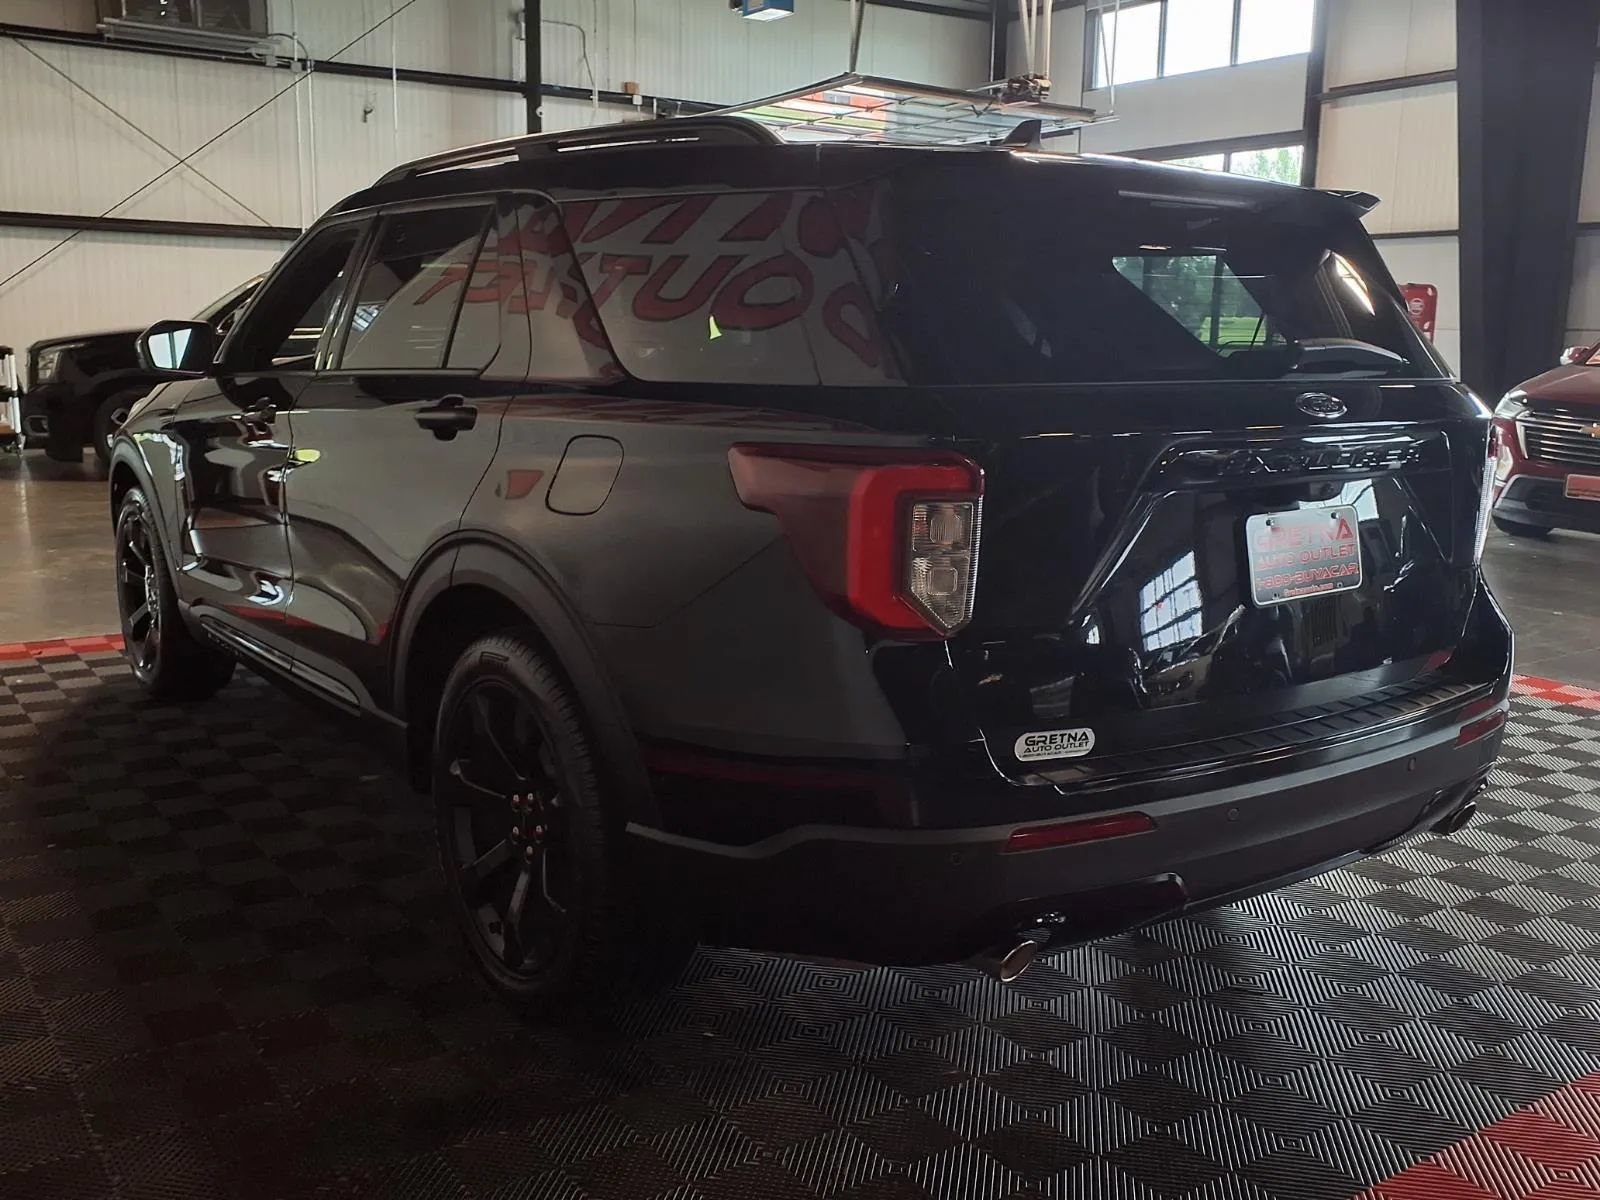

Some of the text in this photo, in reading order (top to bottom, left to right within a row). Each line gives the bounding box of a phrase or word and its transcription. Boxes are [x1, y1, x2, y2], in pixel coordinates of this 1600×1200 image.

[1255, 517, 1354, 549] GRETNA
[1300, 544, 1356, 563] OUTLET
[1024, 745, 1052, 753] AUTO
[1054, 741, 1089, 750] OUTLET
[1025, 731, 1089, 746] GRETNA
